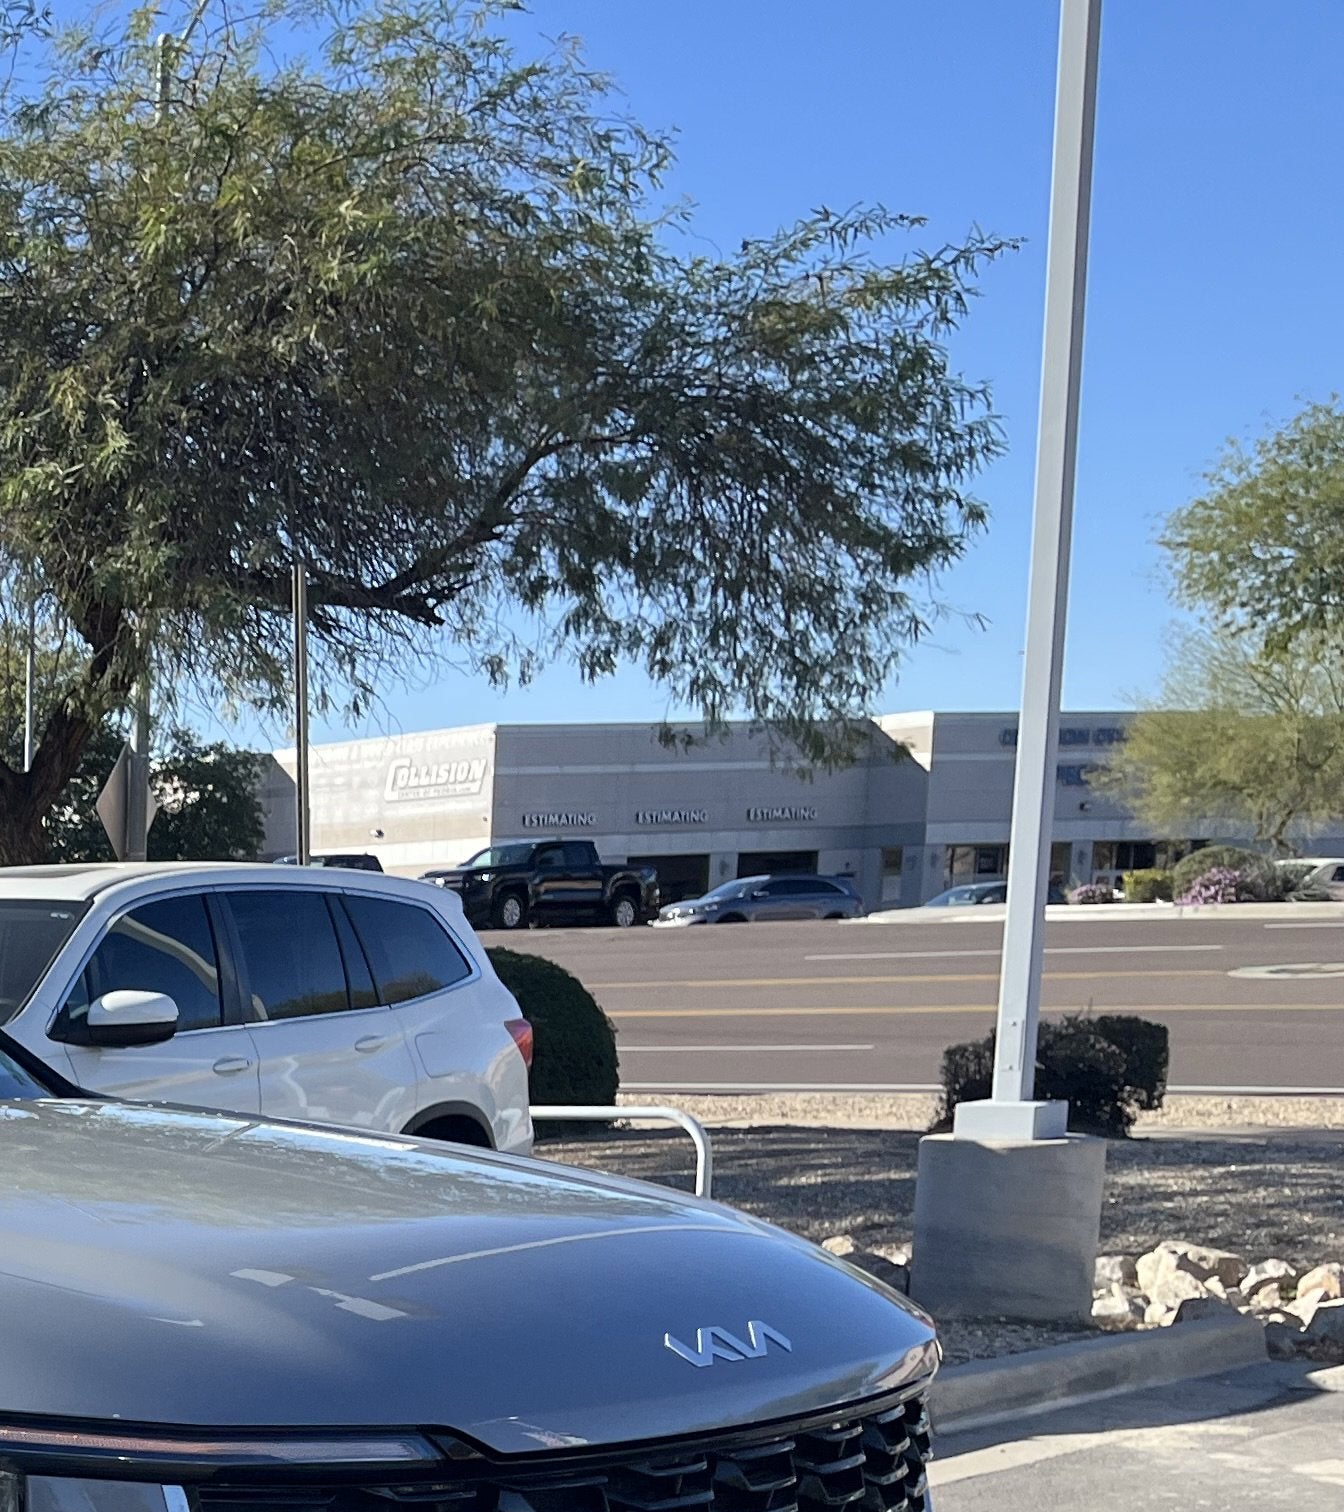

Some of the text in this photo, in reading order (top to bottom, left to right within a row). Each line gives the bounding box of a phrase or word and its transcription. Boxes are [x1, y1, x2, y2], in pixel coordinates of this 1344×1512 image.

[384, 757, 486, 802] COLLISION
[522, 813, 597, 827] ESTIMATING
[635, 808, 709, 824] ESTIMATING
[746, 806, 818, 822] ESTIMATING
[664, 1319, 793, 1367] KIA
